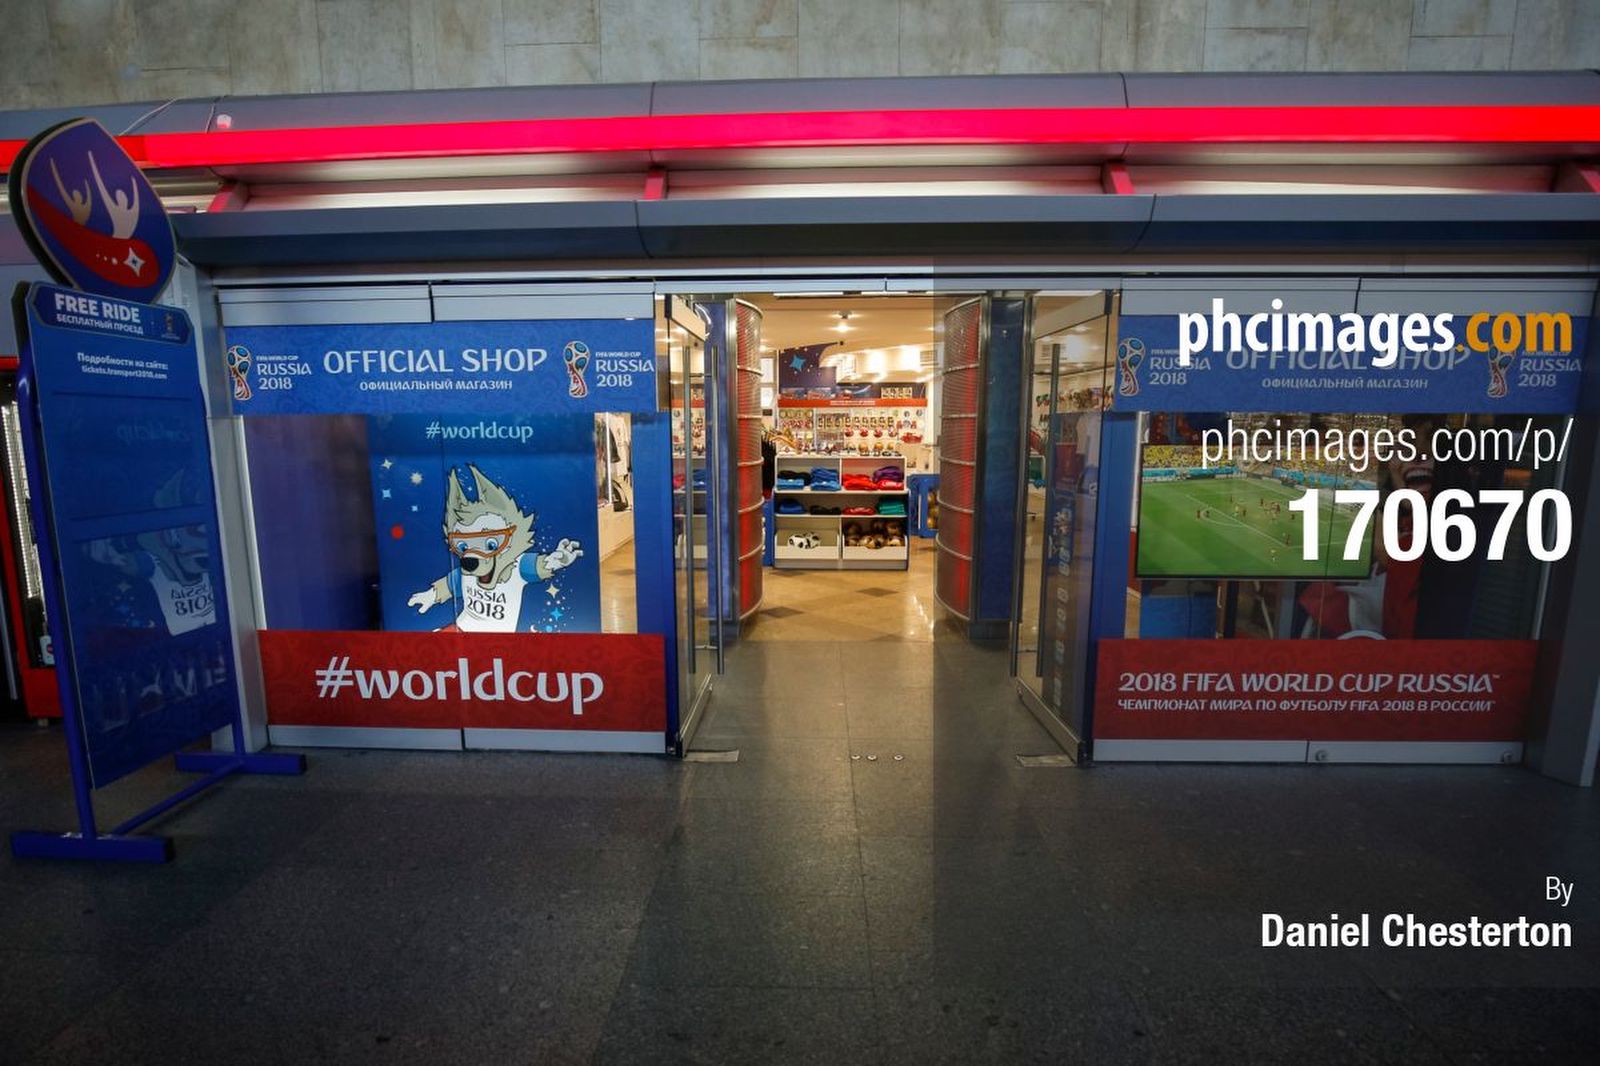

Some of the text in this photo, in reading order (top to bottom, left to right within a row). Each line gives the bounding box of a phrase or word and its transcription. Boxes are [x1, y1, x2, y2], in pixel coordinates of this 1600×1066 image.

[54, 292, 141, 323] FREE RIDE
[56, 313, 144, 335] БЕСПЛАТНЫЙ ПРОЕЗД
[77, 352, 134, 367] Подробности
[323, 348, 548, 374] OFFICIAL SHOP
[595, 359, 655, 373] RUSSIA
[1519, 357, 1582, 371] RUSSIA
[257, 362, 312, 376] RUSSIA
[258, 376, 293, 390] 2018
[596, 373, 633, 388] 2018
[1149, 371, 1187, 385] 2018
[1261, 377, 1429, 390] ОФИЦИАЛЬНЫЙ МАГАЗИН
[1517, 373, 1557, 388] 2018
[359, 380, 513, 392] ОФИЦИАЛЬНЫЙ МАГАЗИН
[425, 421, 534, 444] #worldcup
[467, 596, 505, 620] 2018
[315, 656, 604, 715] #worldcup
[1118, 672, 1177, 692] 2018
[1181, 672, 1235, 692] FIFA
[1241, 673, 1334, 693] WORLD
[1338, 673, 1393, 693] CUP
[1118, 699, 1207, 711] ЧЕМПИОНАТ
[1209, 699, 1253, 711] МИРА
[1255, 700, 1277, 711] ПО
[1279, 700, 1347, 712] ФУТБОЛУ
[1349, 700, 1380, 711] FIFA
[1382, 700, 1415, 712] 2018
[1417, 700, 1428, 712] В
